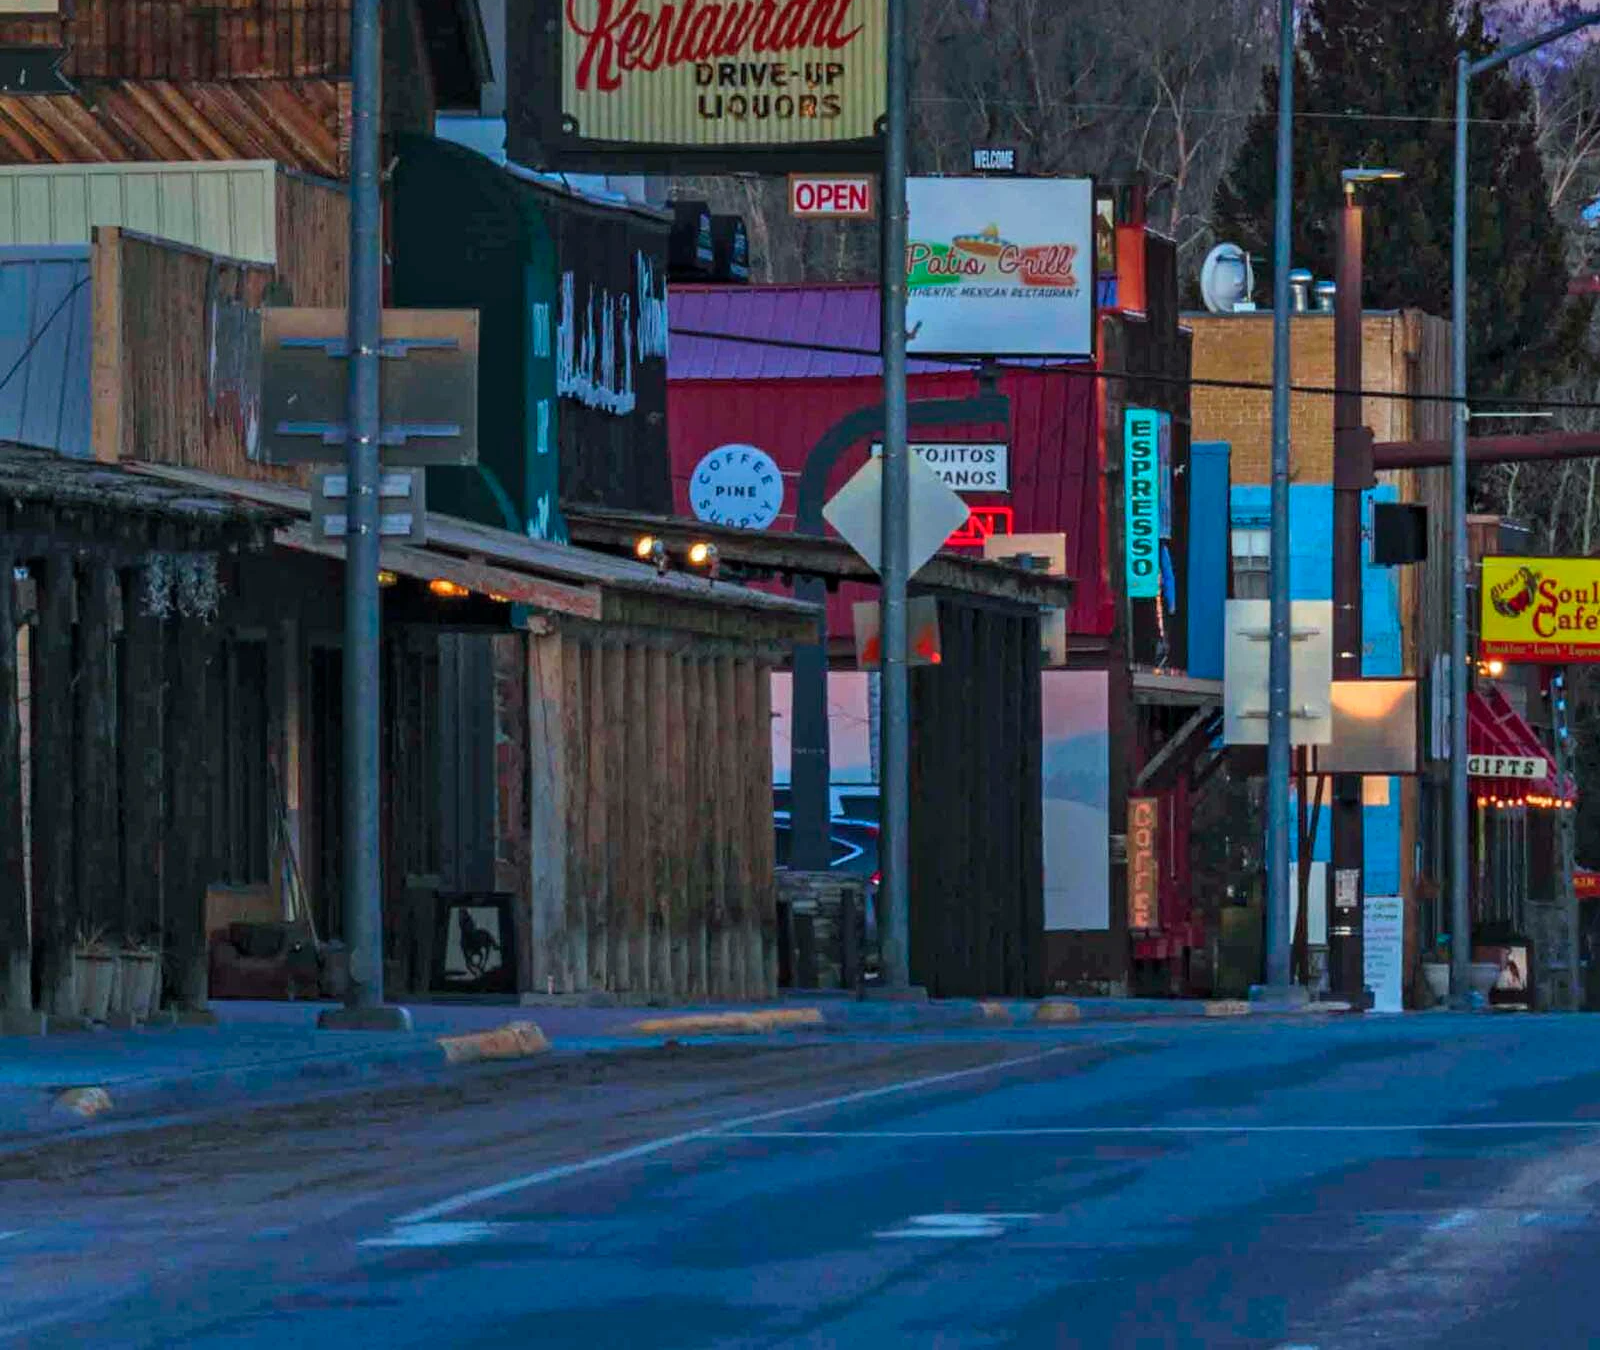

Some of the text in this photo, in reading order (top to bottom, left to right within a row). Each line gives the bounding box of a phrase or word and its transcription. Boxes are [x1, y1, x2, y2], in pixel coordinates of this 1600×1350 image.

[694, 61, 846, 88] DRIVE-UP
[697, 94, 843, 120] LIQUORS
[973, 149, 1016, 170] WELCOME
[795, 183, 868, 211] OPEN
[905, 242, 1074, 276] Patio Grill
[905, 286, 1081, 300] THENTIC MEXICAN RESTAURANT
[699, 452, 774, 486] COFFEE
[715, 486, 757, 498] PINE
[1131, 419, 1154, 577] ESPRESSO
[699, 498, 774, 530] SUPPLY
[1538, 578, 1600, 616] Soul
[1468, 757, 1536, 776] GIFTS
